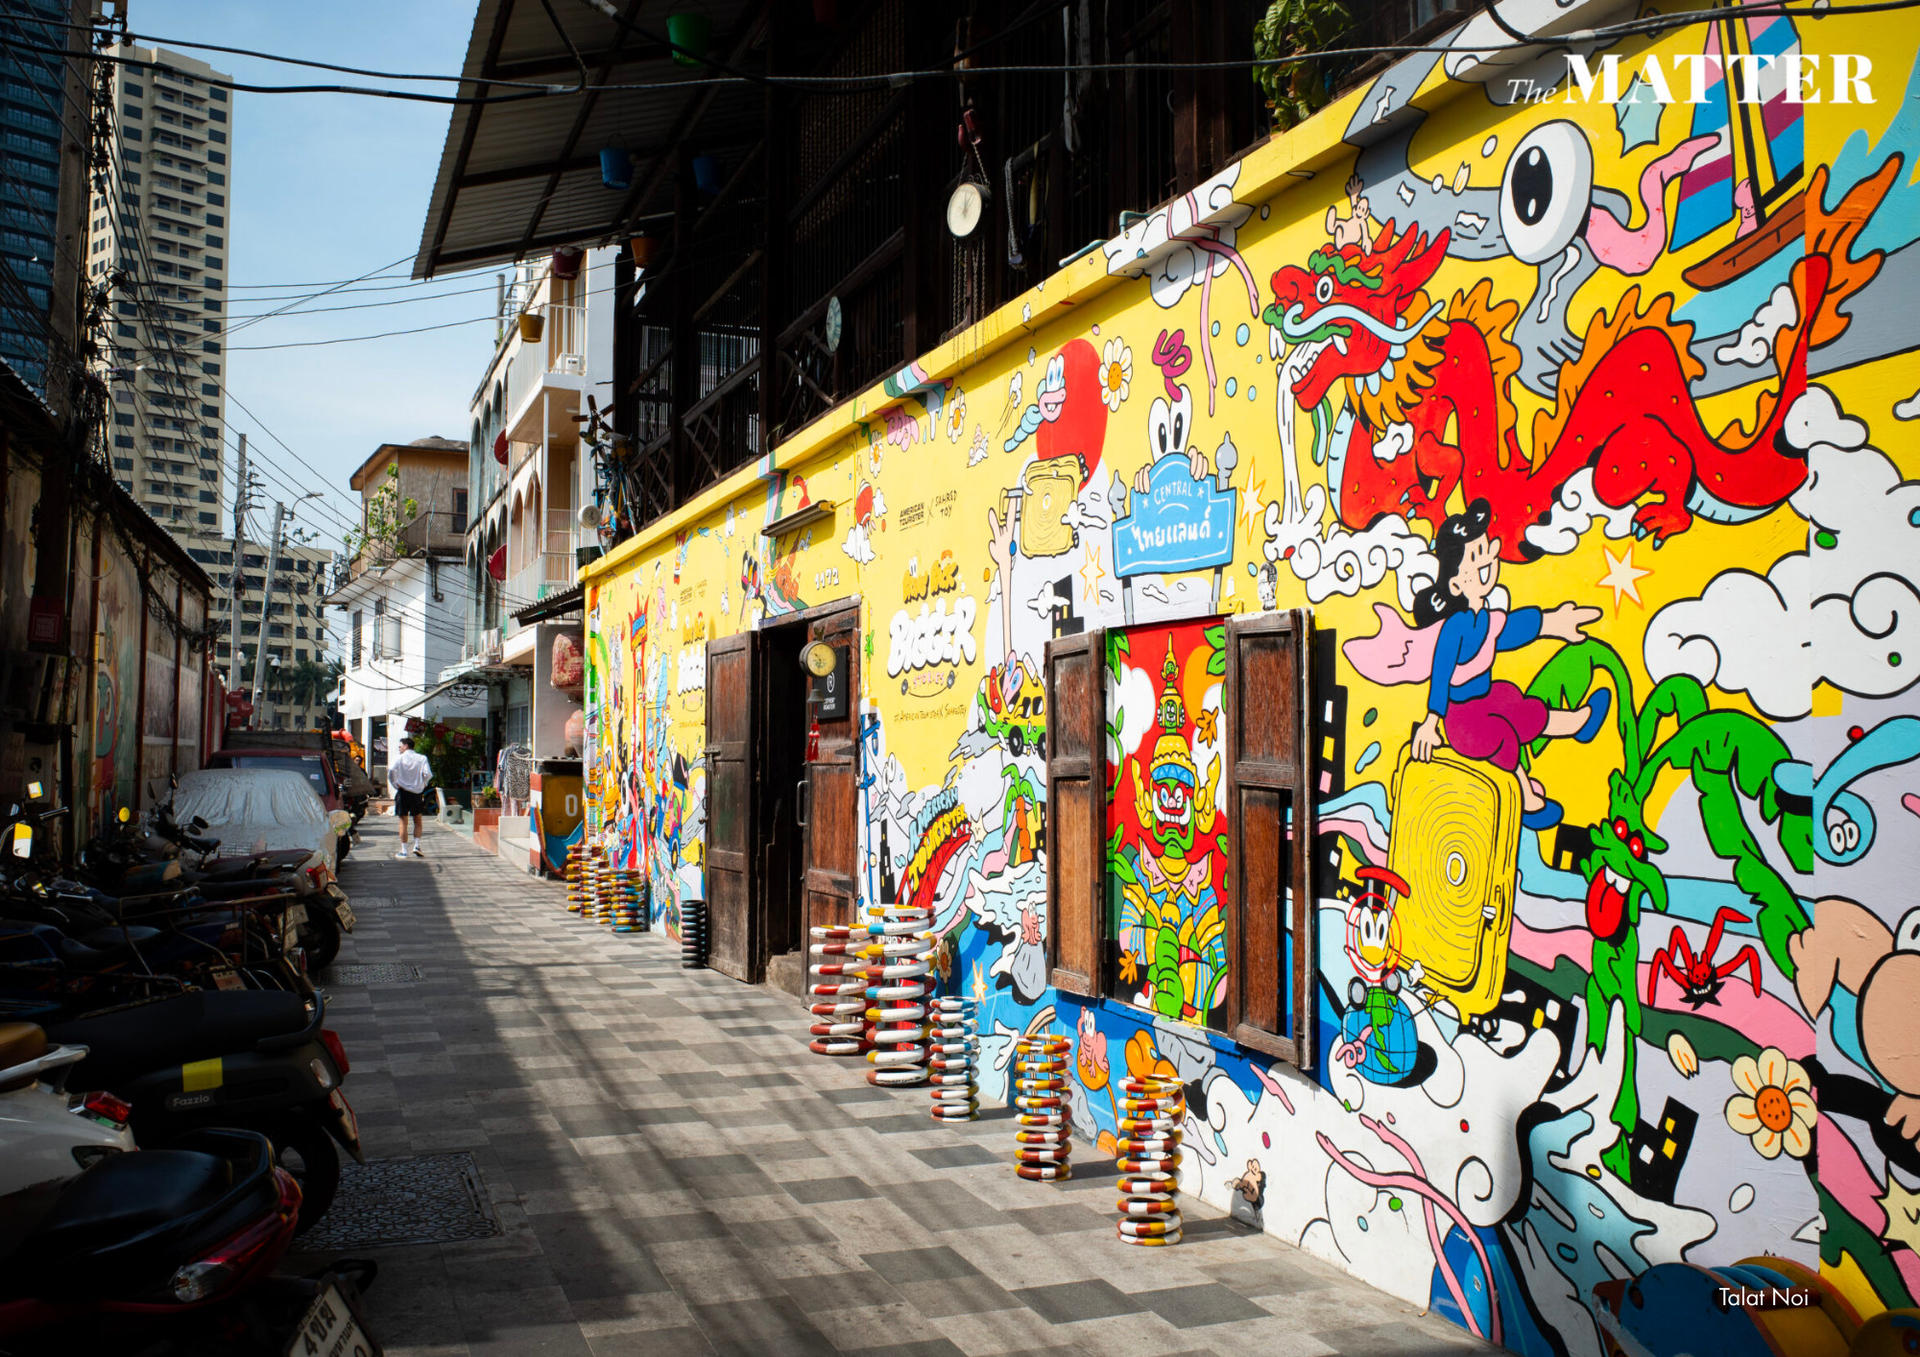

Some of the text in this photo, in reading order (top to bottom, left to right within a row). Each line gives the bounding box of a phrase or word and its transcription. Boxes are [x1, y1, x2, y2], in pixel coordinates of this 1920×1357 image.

[1153, 479, 1193, 505] CENTRAL
[899, 502, 925, 518] AMERICAN
[899, 511, 925, 528] TOURISTER
[940, 504, 953, 518] TOY
[1131, 504, 1212, 552] ไทยแลนด์
[887, 595, 977, 679] BIGGER
[913, 670, 945, 688] STORIES
[907, 785, 958, 863] AMERICAN
[908, 802, 969, 892] TOURISTER
[172, 1094, 210, 1107] Fazzio
